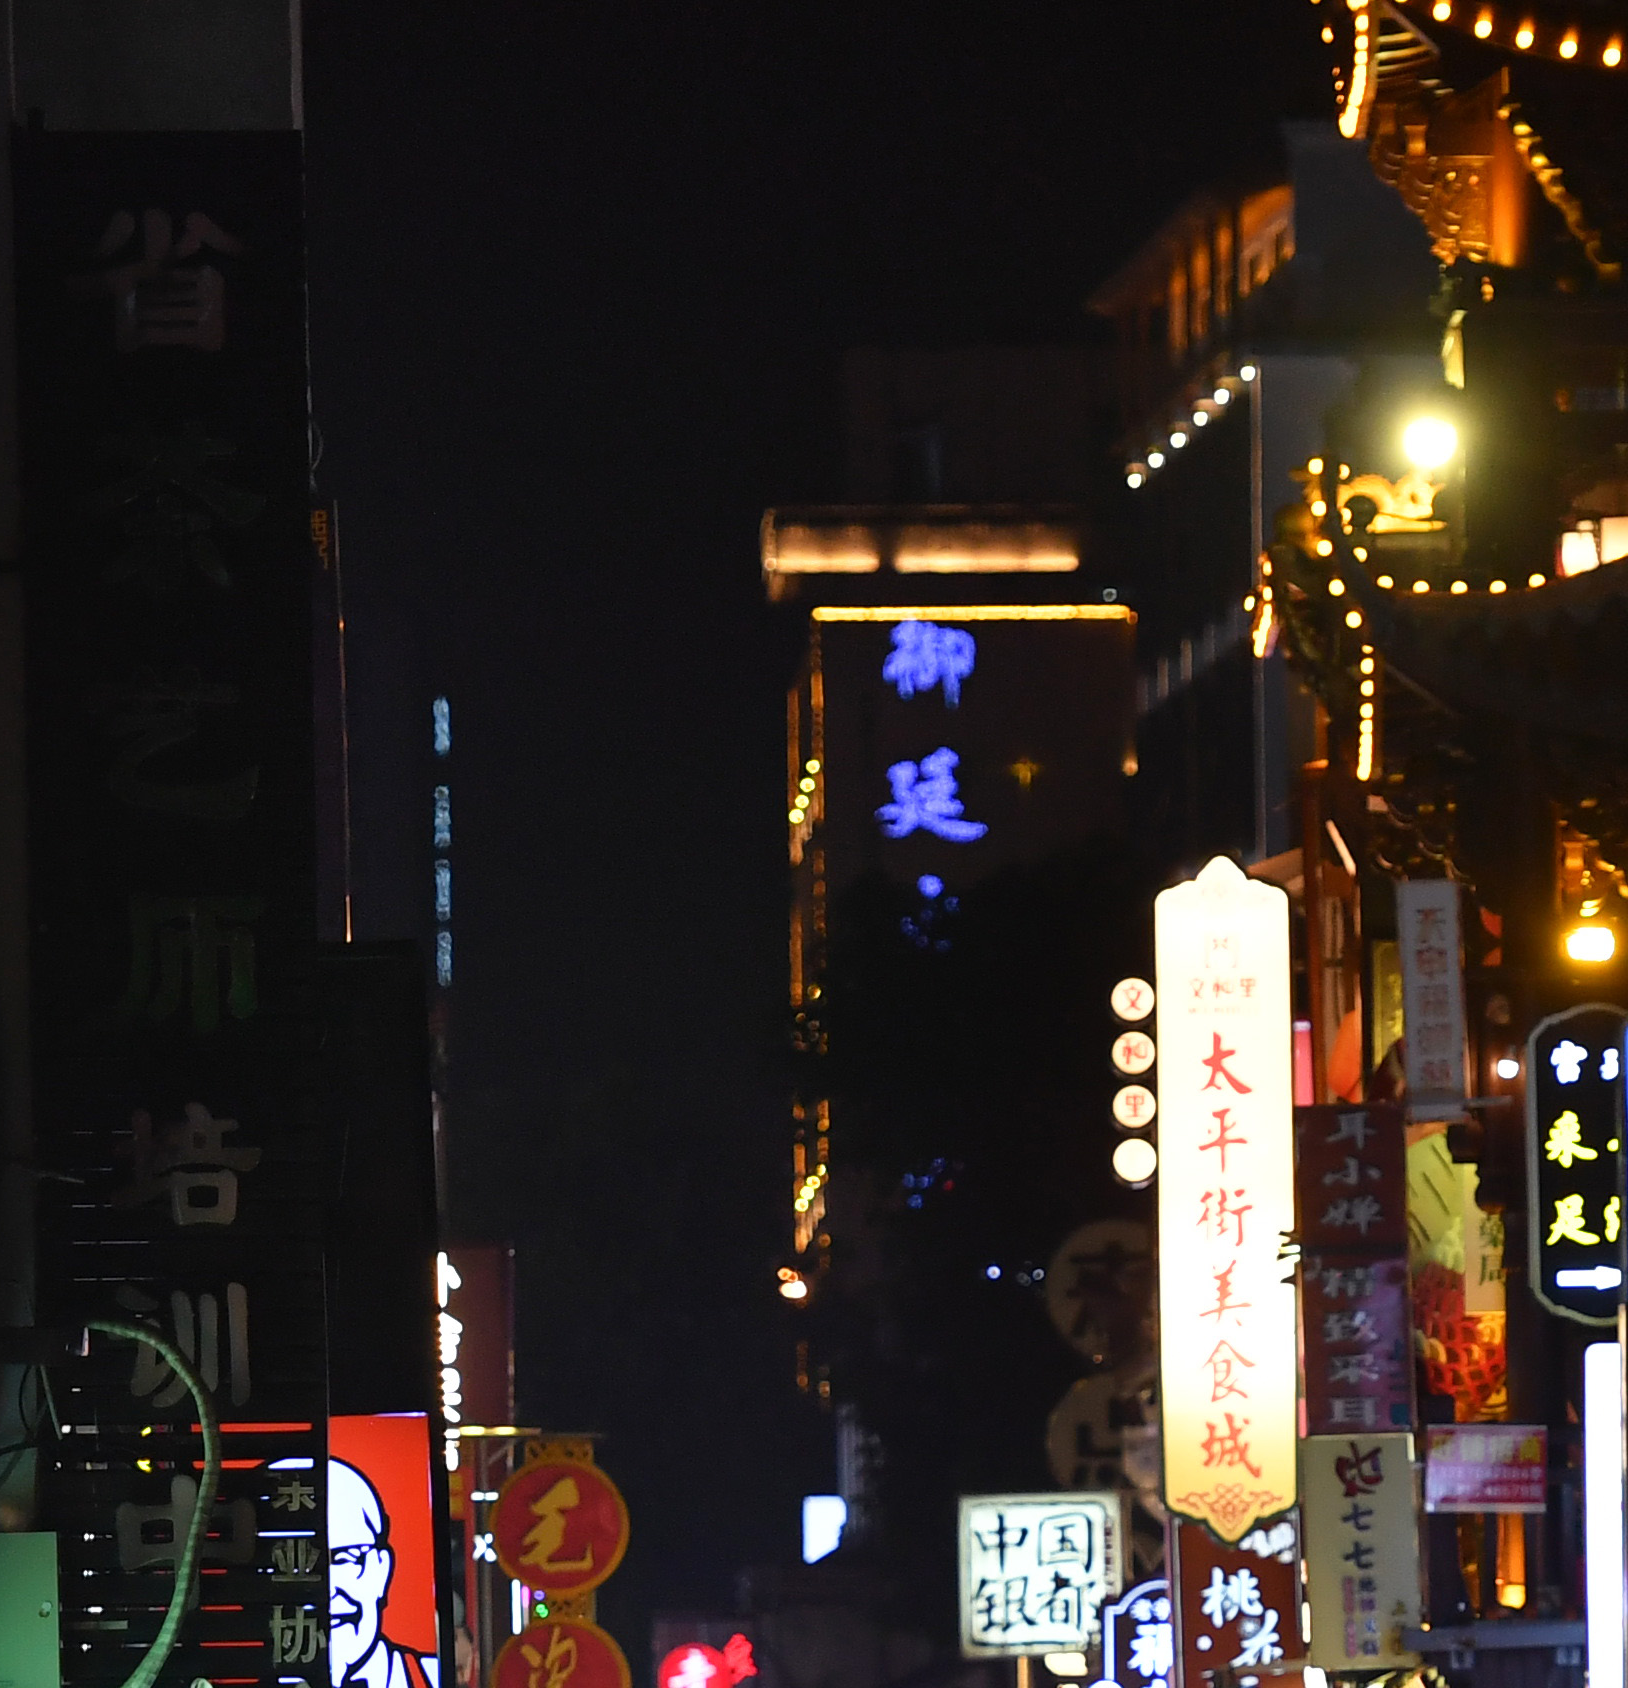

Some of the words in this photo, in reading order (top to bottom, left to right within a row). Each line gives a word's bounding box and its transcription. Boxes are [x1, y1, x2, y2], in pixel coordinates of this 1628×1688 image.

[1196, 1032, 1262, 1479] 太平街美食城
[973, 1512, 1094, 1574] 中国
